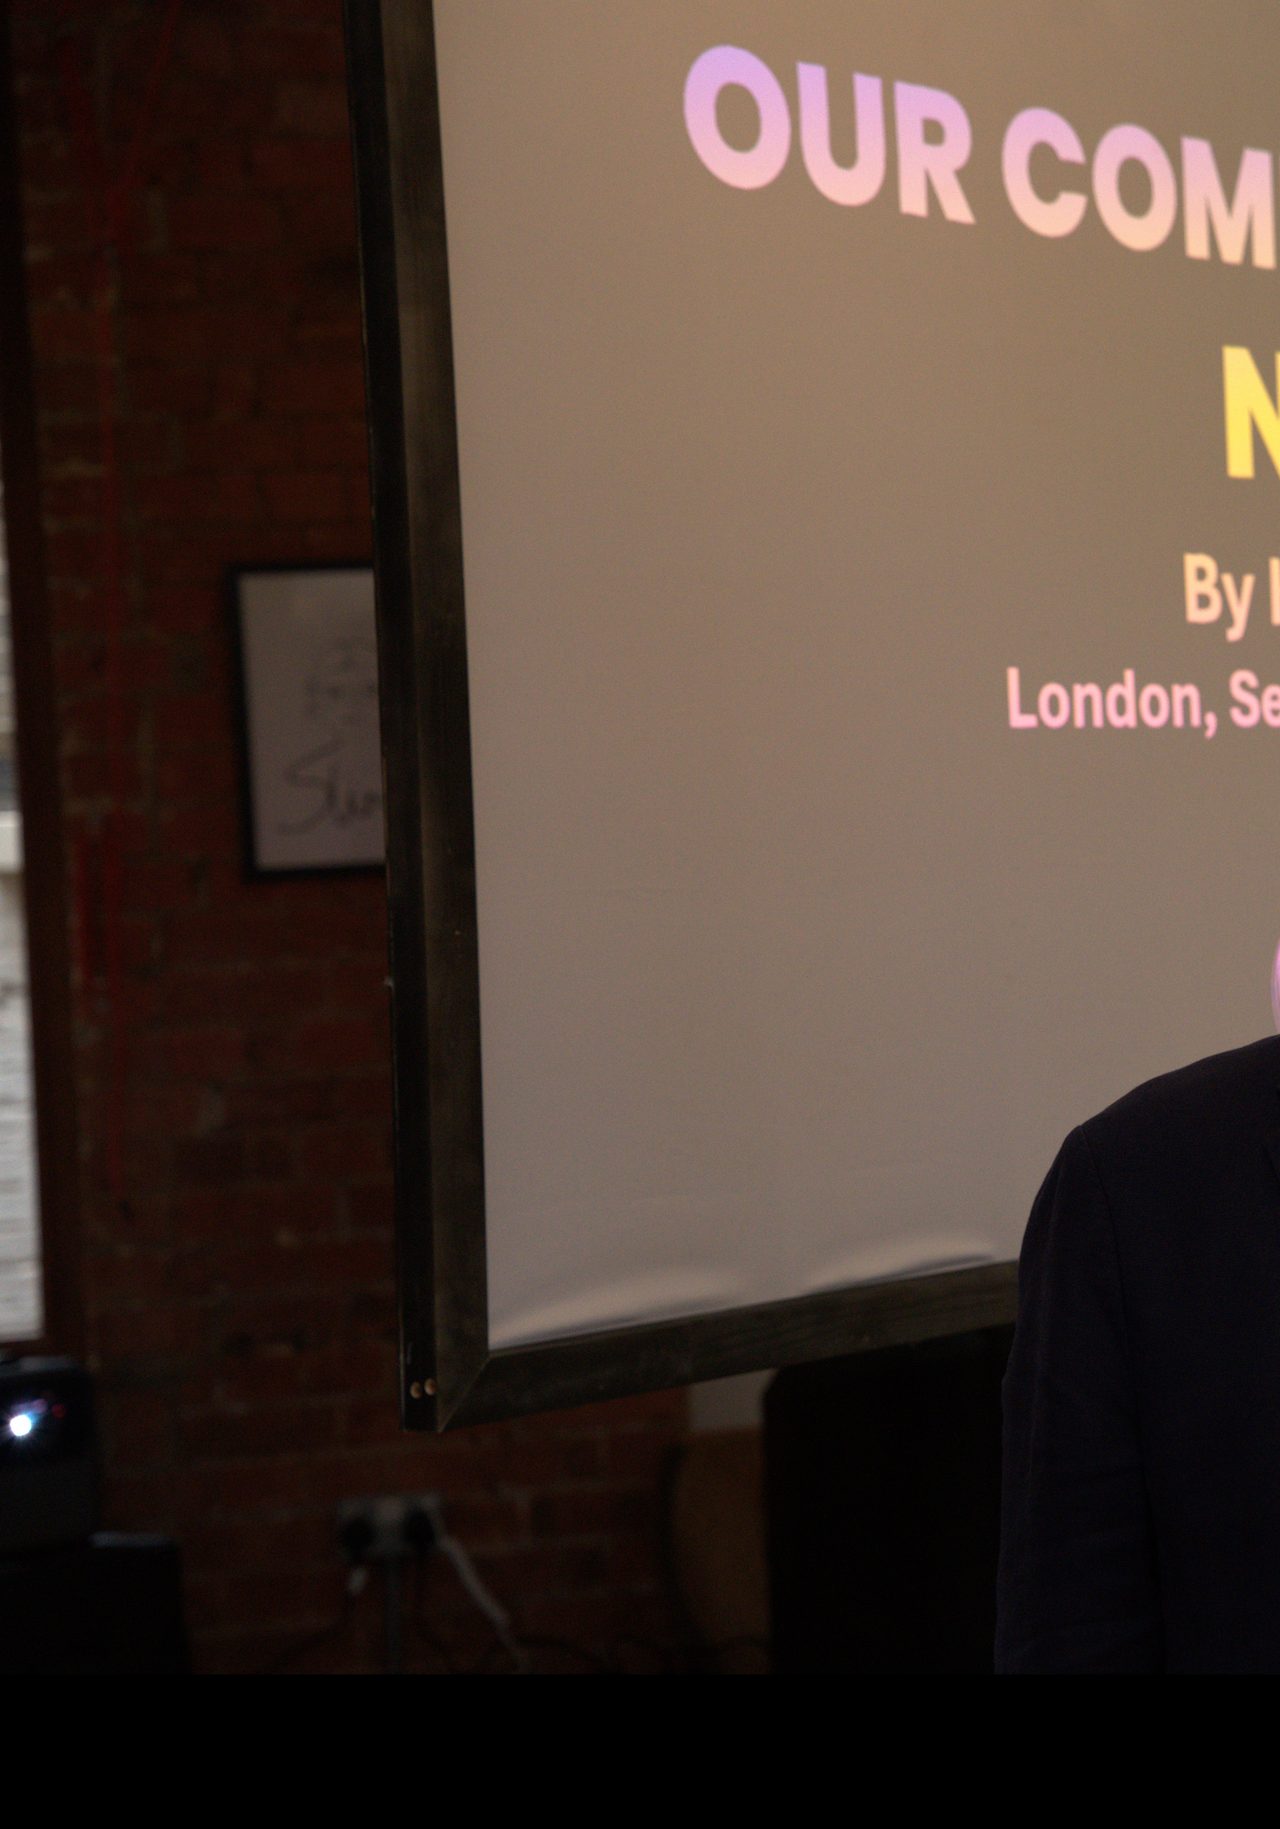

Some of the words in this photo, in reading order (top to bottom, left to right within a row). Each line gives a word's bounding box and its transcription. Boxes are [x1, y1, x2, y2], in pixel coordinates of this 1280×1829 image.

[683, 44, 976, 225] OUR
[1182, 552, 1256, 642] By
[1005, 666, 1218, 739] London,
